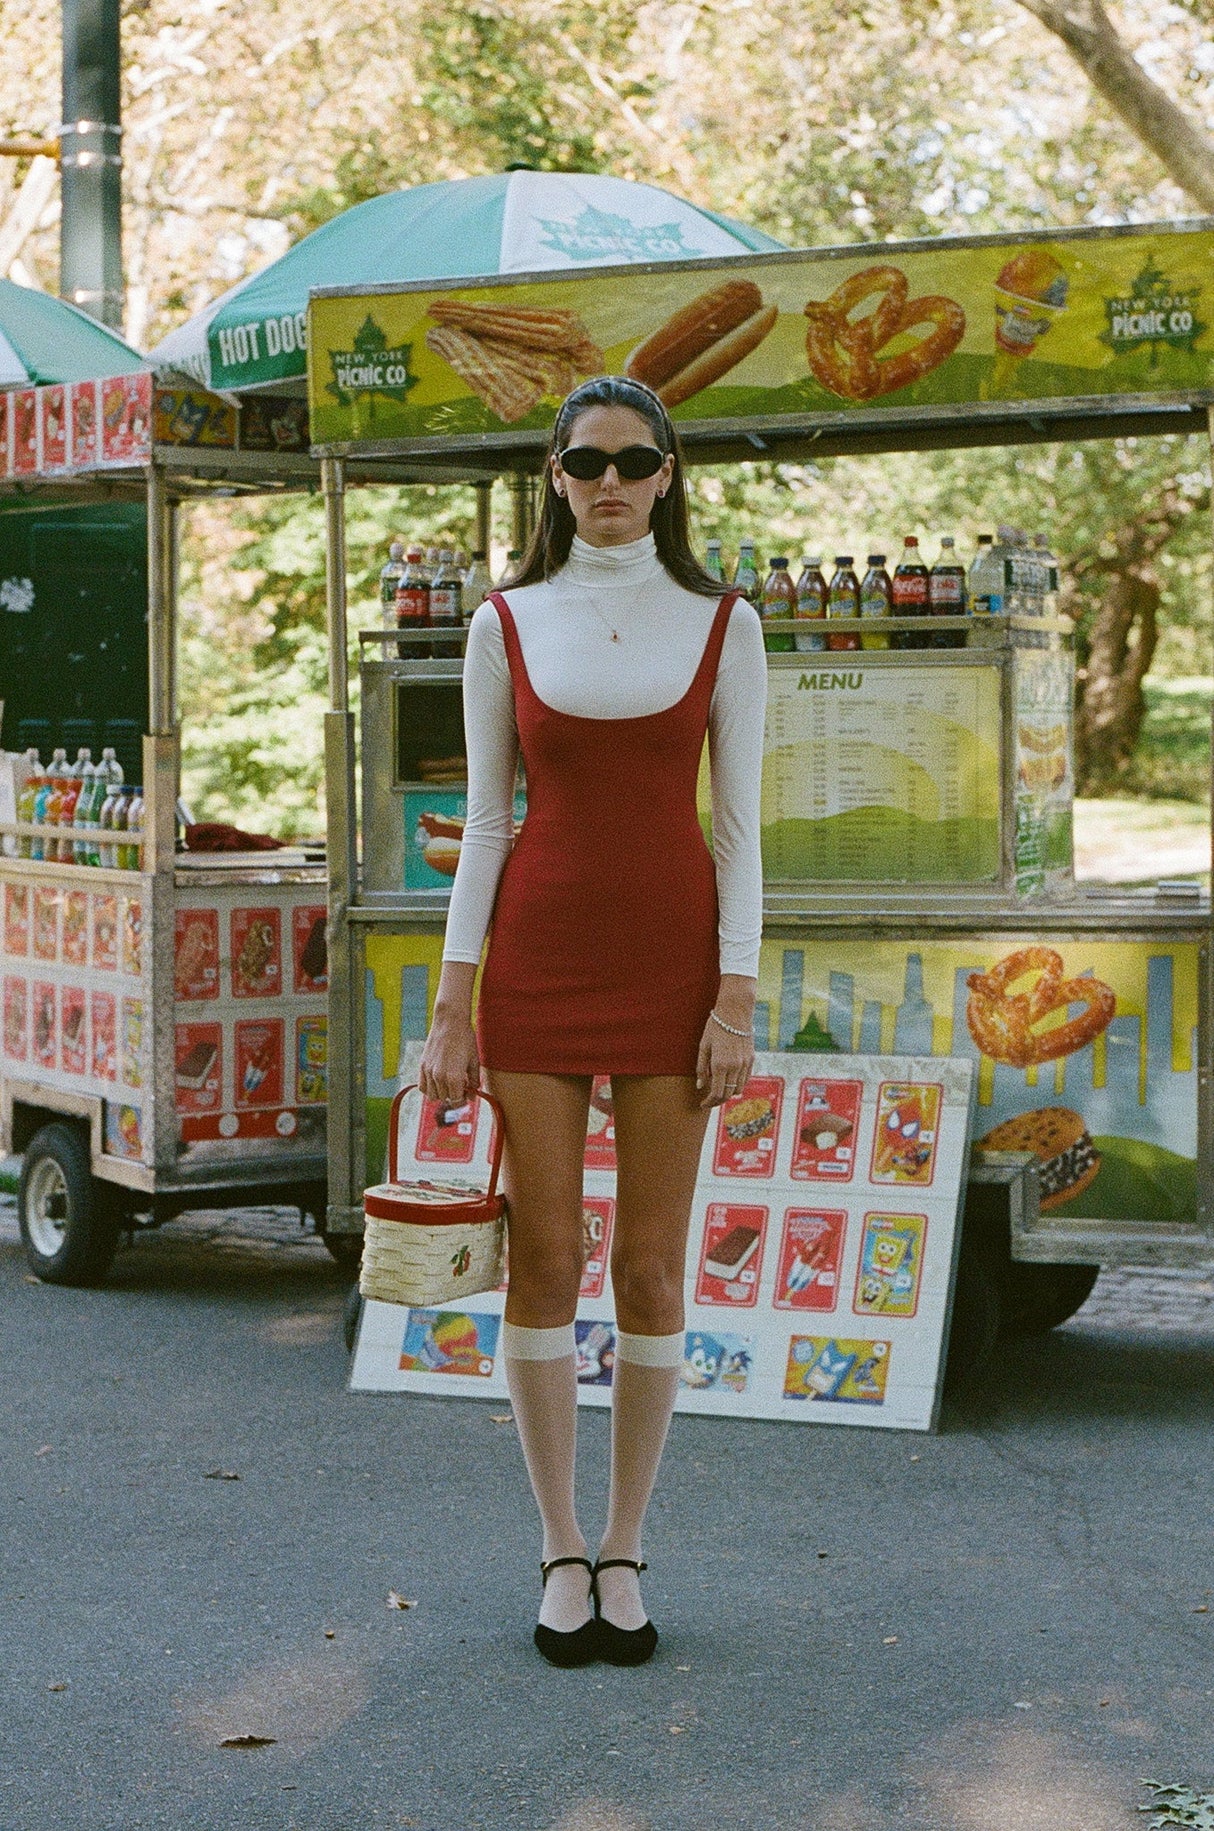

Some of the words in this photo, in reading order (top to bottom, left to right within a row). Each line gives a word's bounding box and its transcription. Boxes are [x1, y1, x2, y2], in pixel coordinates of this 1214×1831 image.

[1169, 311, 1193, 335] CO
[219, 322, 260, 367] HOT
[335, 353, 366, 364] NEW
[386, 365, 406, 385] CO
[797, 672, 863, 691] MENU
